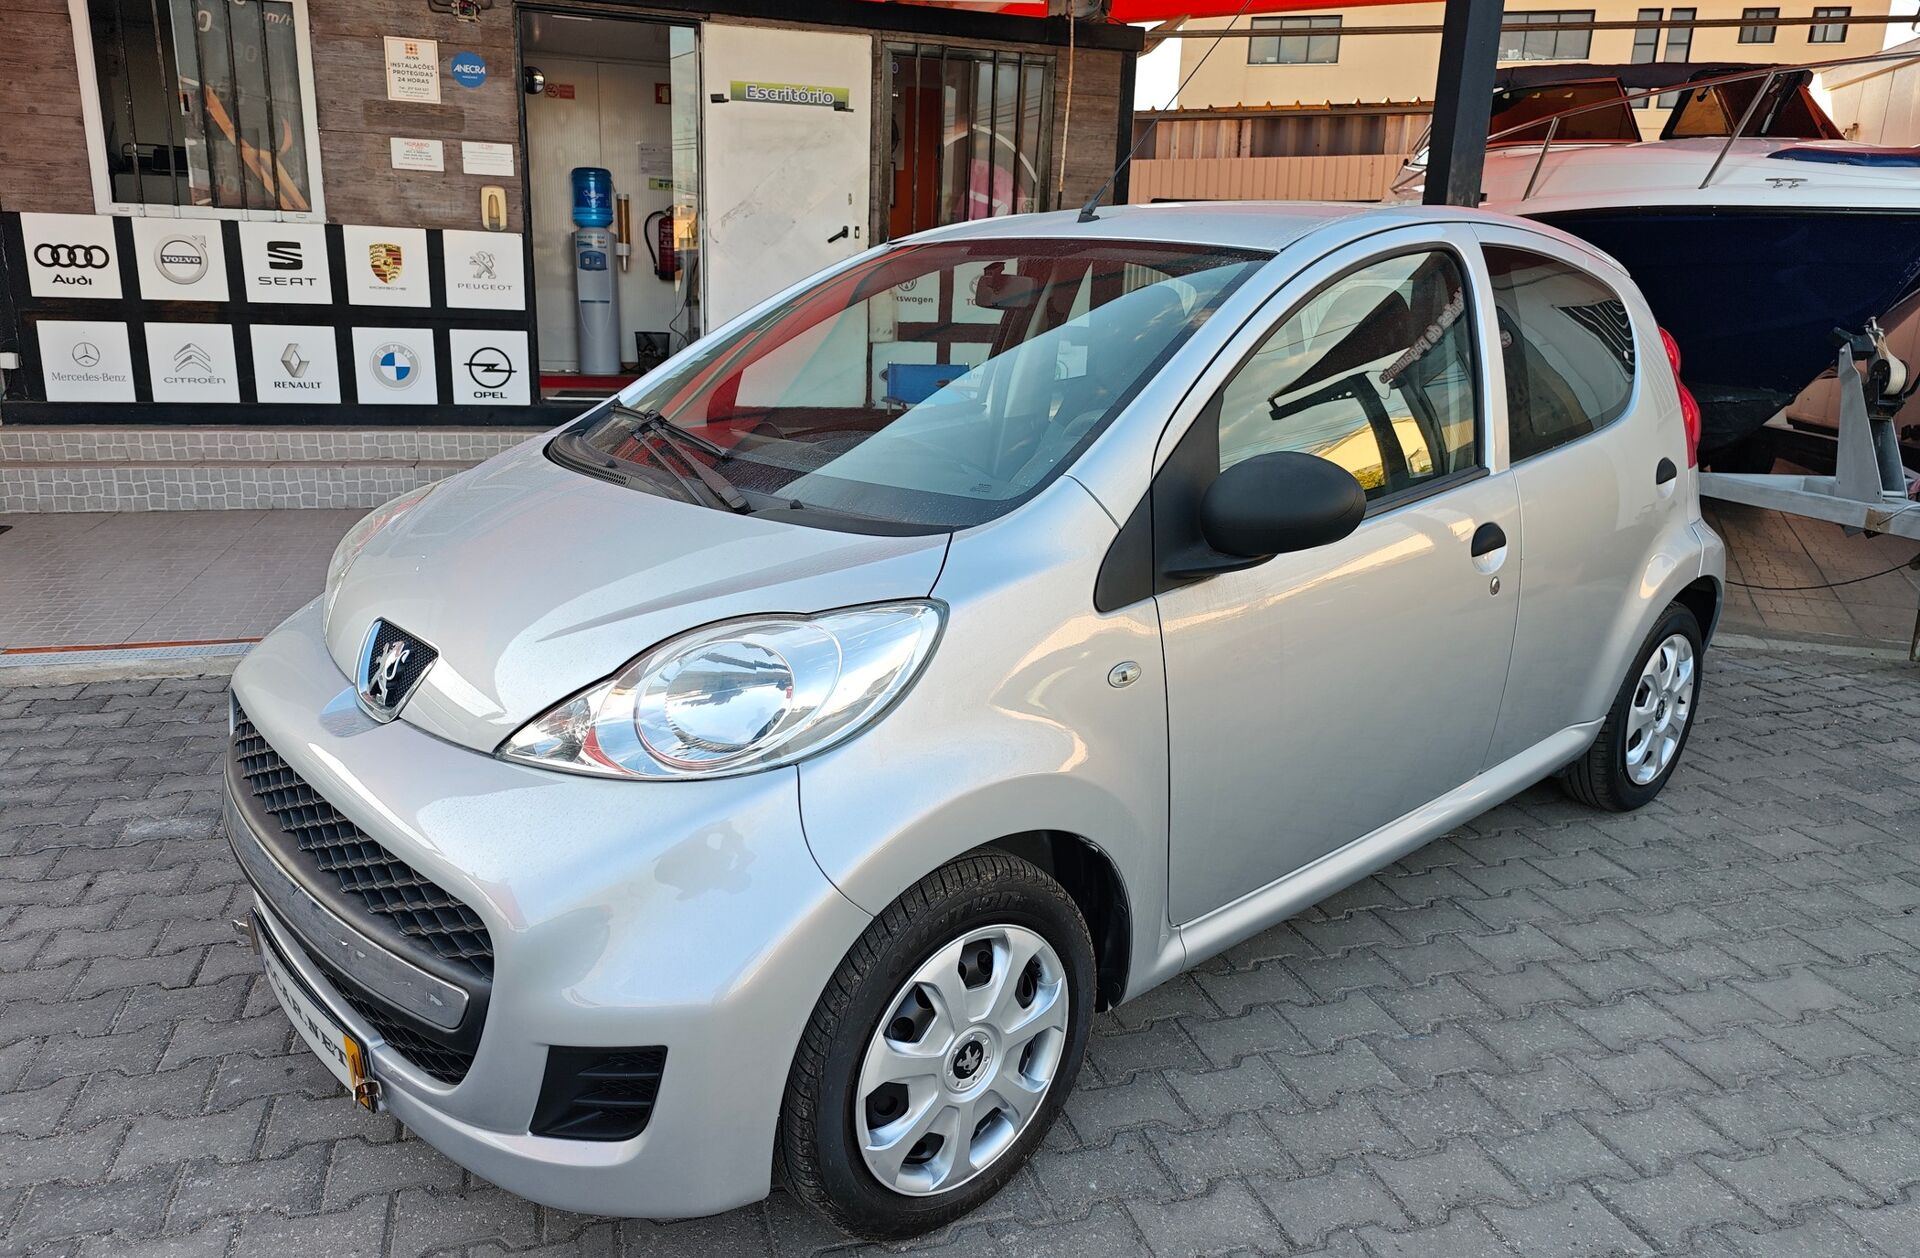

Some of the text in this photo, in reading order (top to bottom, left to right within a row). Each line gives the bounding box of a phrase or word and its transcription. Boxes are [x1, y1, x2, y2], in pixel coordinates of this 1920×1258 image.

[391, 62, 434, 70] INSTALAÇÕES
[454, 64, 486, 75] ANECRA
[745, 83, 835, 105] Escritório
[162, 256, 201, 264] VOLVO
[52, 274, 92, 285] Audi
[258, 277, 317, 286] SEAT
[457, 282, 513, 291] PEUGEOT
[51, 372, 127, 382] Mercedes-Benz
[273, 381, 322, 389] RENAULT
[473, 391, 508, 399] OPEL
